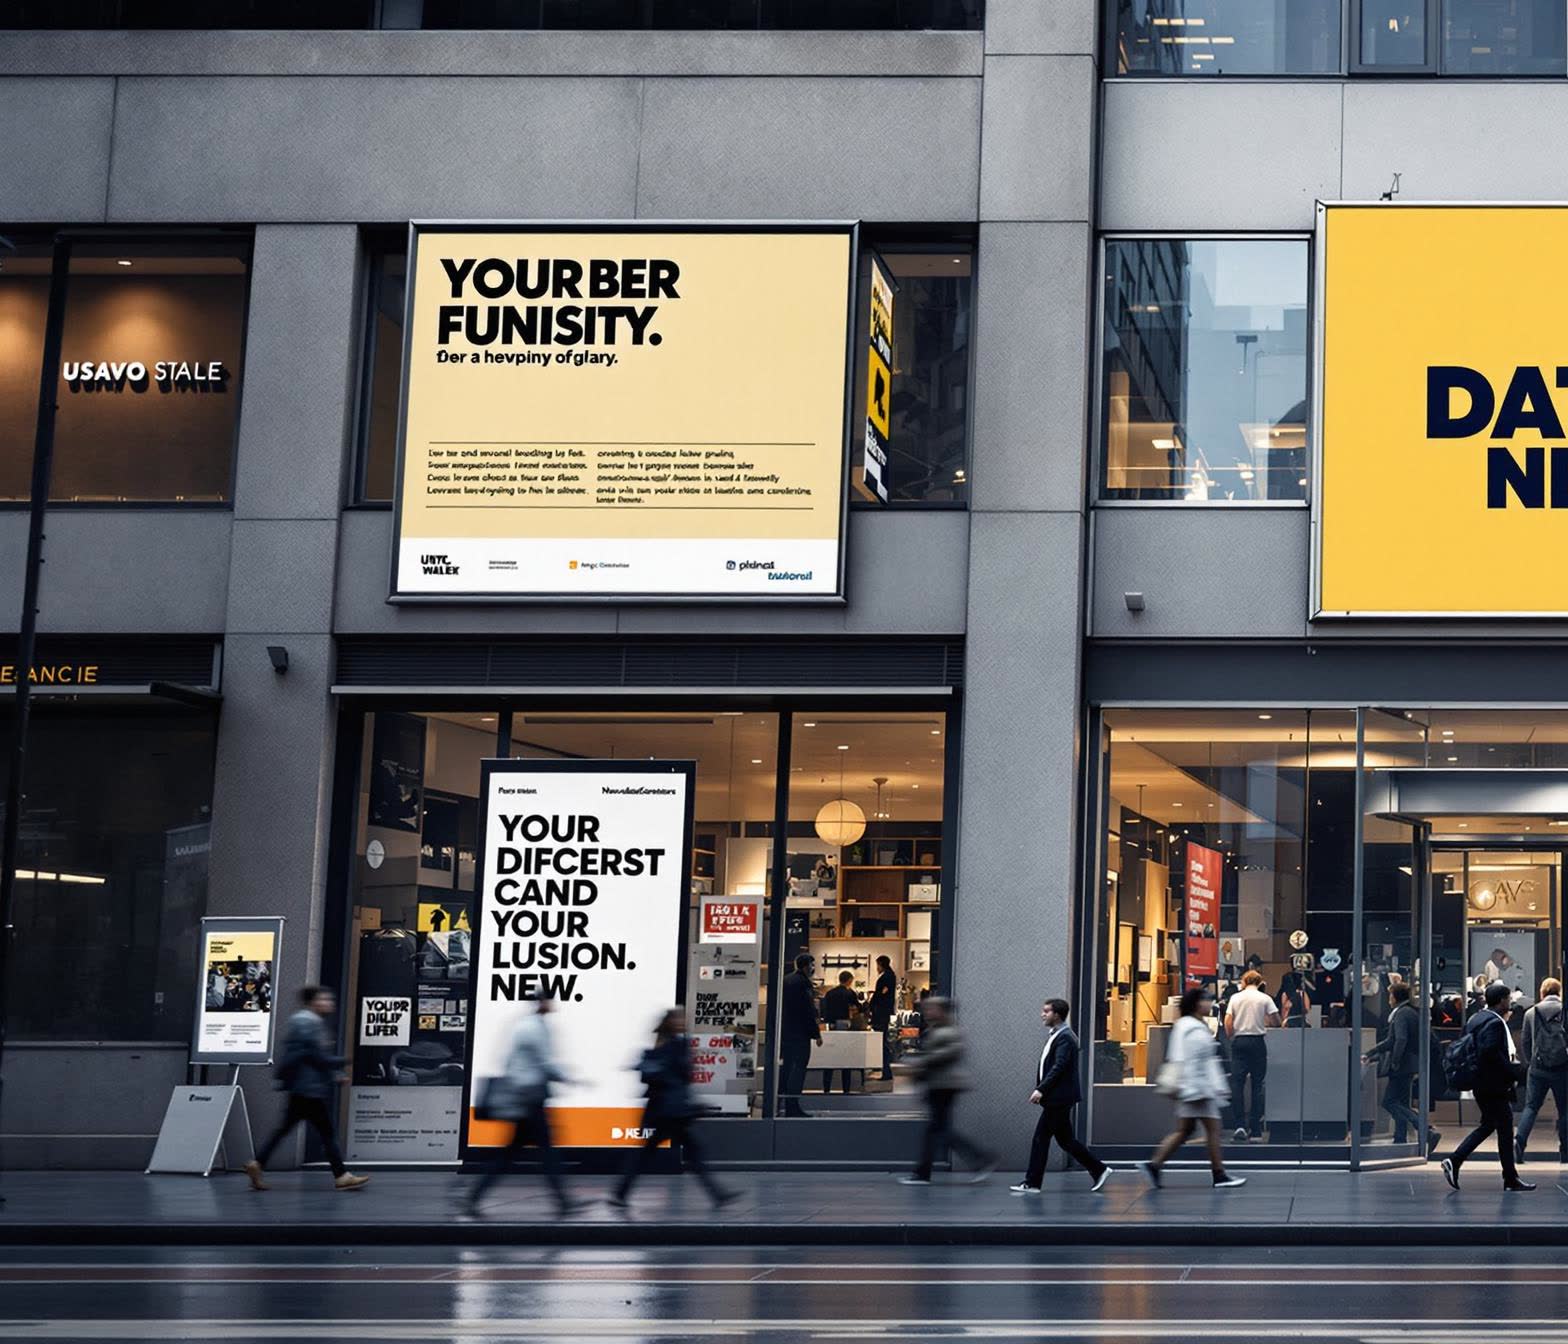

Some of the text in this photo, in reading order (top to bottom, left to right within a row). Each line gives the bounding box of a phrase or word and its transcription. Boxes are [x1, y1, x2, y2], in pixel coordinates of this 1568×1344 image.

[439, 257, 681, 300] YOUR BER
[437, 305, 663, 347] FUNISITY.
[63, 361, 222, 381] USAVO STALE
[470, 353, 481, 364] a
[484, 350, 551, 367] hevpiny
[498, 814, 600, 843] YOUR
[496, 847, 666, 877] DIFCERST
[494, 878, 598, 907] CAND
[490, 909, 589, 938] YOUR
[492, 941, 637, 971] LUSION.
[490, 973, 584, 1003] NEW.
